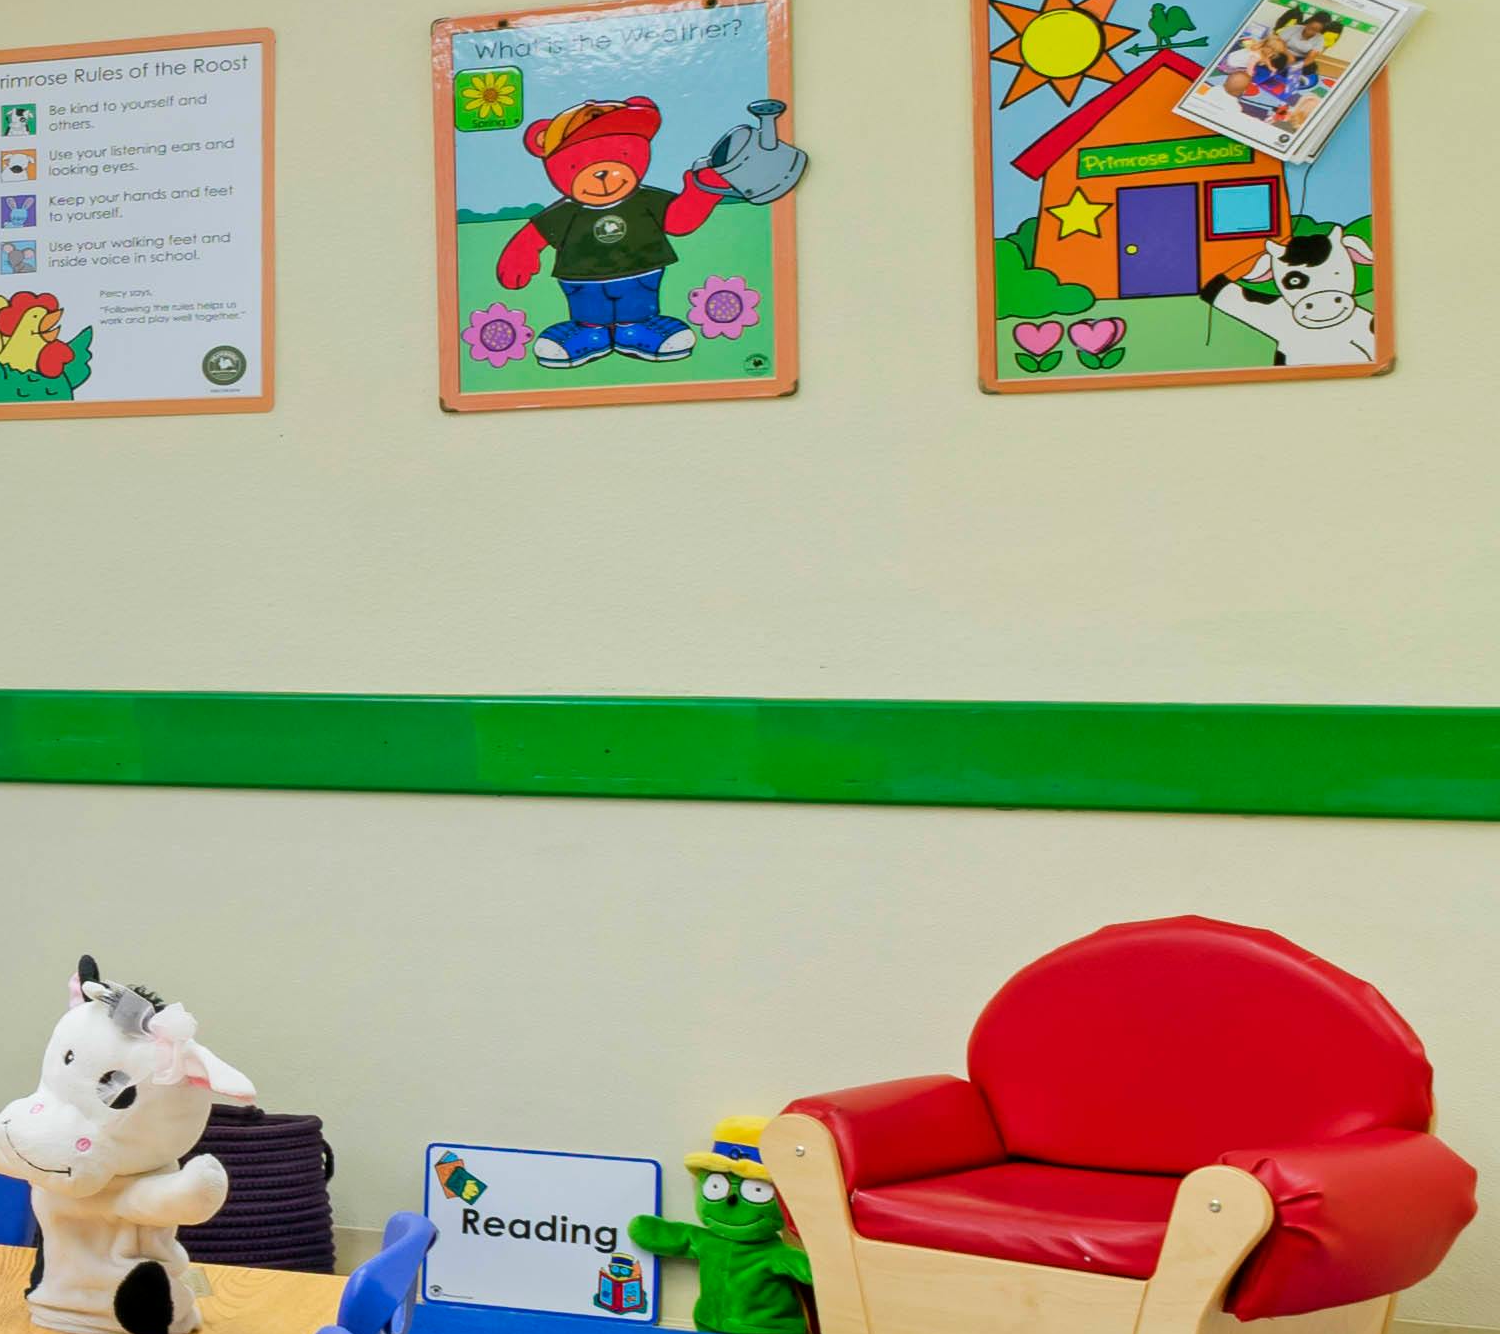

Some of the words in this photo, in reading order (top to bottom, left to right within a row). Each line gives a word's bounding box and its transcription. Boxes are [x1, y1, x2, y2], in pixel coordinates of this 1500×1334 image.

[474, 41, 540, 60] What
[545, 38, 563, 55] is
[572, 34, 611, 53] the
[621, 19, 742, 44] Weather?
[74, 65, 124, 84] Rules
[129, 62, 149, 79] of
[155, 60, 187, 77] the
[193, 55, 248, 75] Roost
[49, 105, 66, 116] Be
[70, 101, 99, 114] kind
[103, 100, 117, 112] to
[120, 95, 174, 113] yourself
[178, 93, 208, 107] and
[49, 119, 95, 132] others.
[49, 149, 72, 161] Use
[76, 148, 108, 161] your
[110, 142, 167, 157] listening
[171, 140, 201, 152] ears
[205, 138, 235, 150] and
[49, 163, 99, 177] looking
[102, 161, 139, 174] eyes.
[1084, 151, 1169, 171] Primrose
[49, 195, 85, 208] Keep
[89, 192, 120, 206] your
[123, 188, 167, 201] hands
[171, 187, 200, 199] and
[204, 185, 235, 197] feet
[49, 212, 63, 222] to
[66, 207, 123, 223] yourself.
[49, 241, 72, 253] Use
[76, 240, 108, 252] your
[110, 234, 164, 249] walking
[168, 233, 198, 246] feet
[201, 232, 231, 244] and
[49, 255, 88, 267] inside
[91, 254, 130, 266] voice
[134, 253, 146, 264] in
[150, 249, 200, 263] school.
[461, 1208, 618, 1254] Reading
